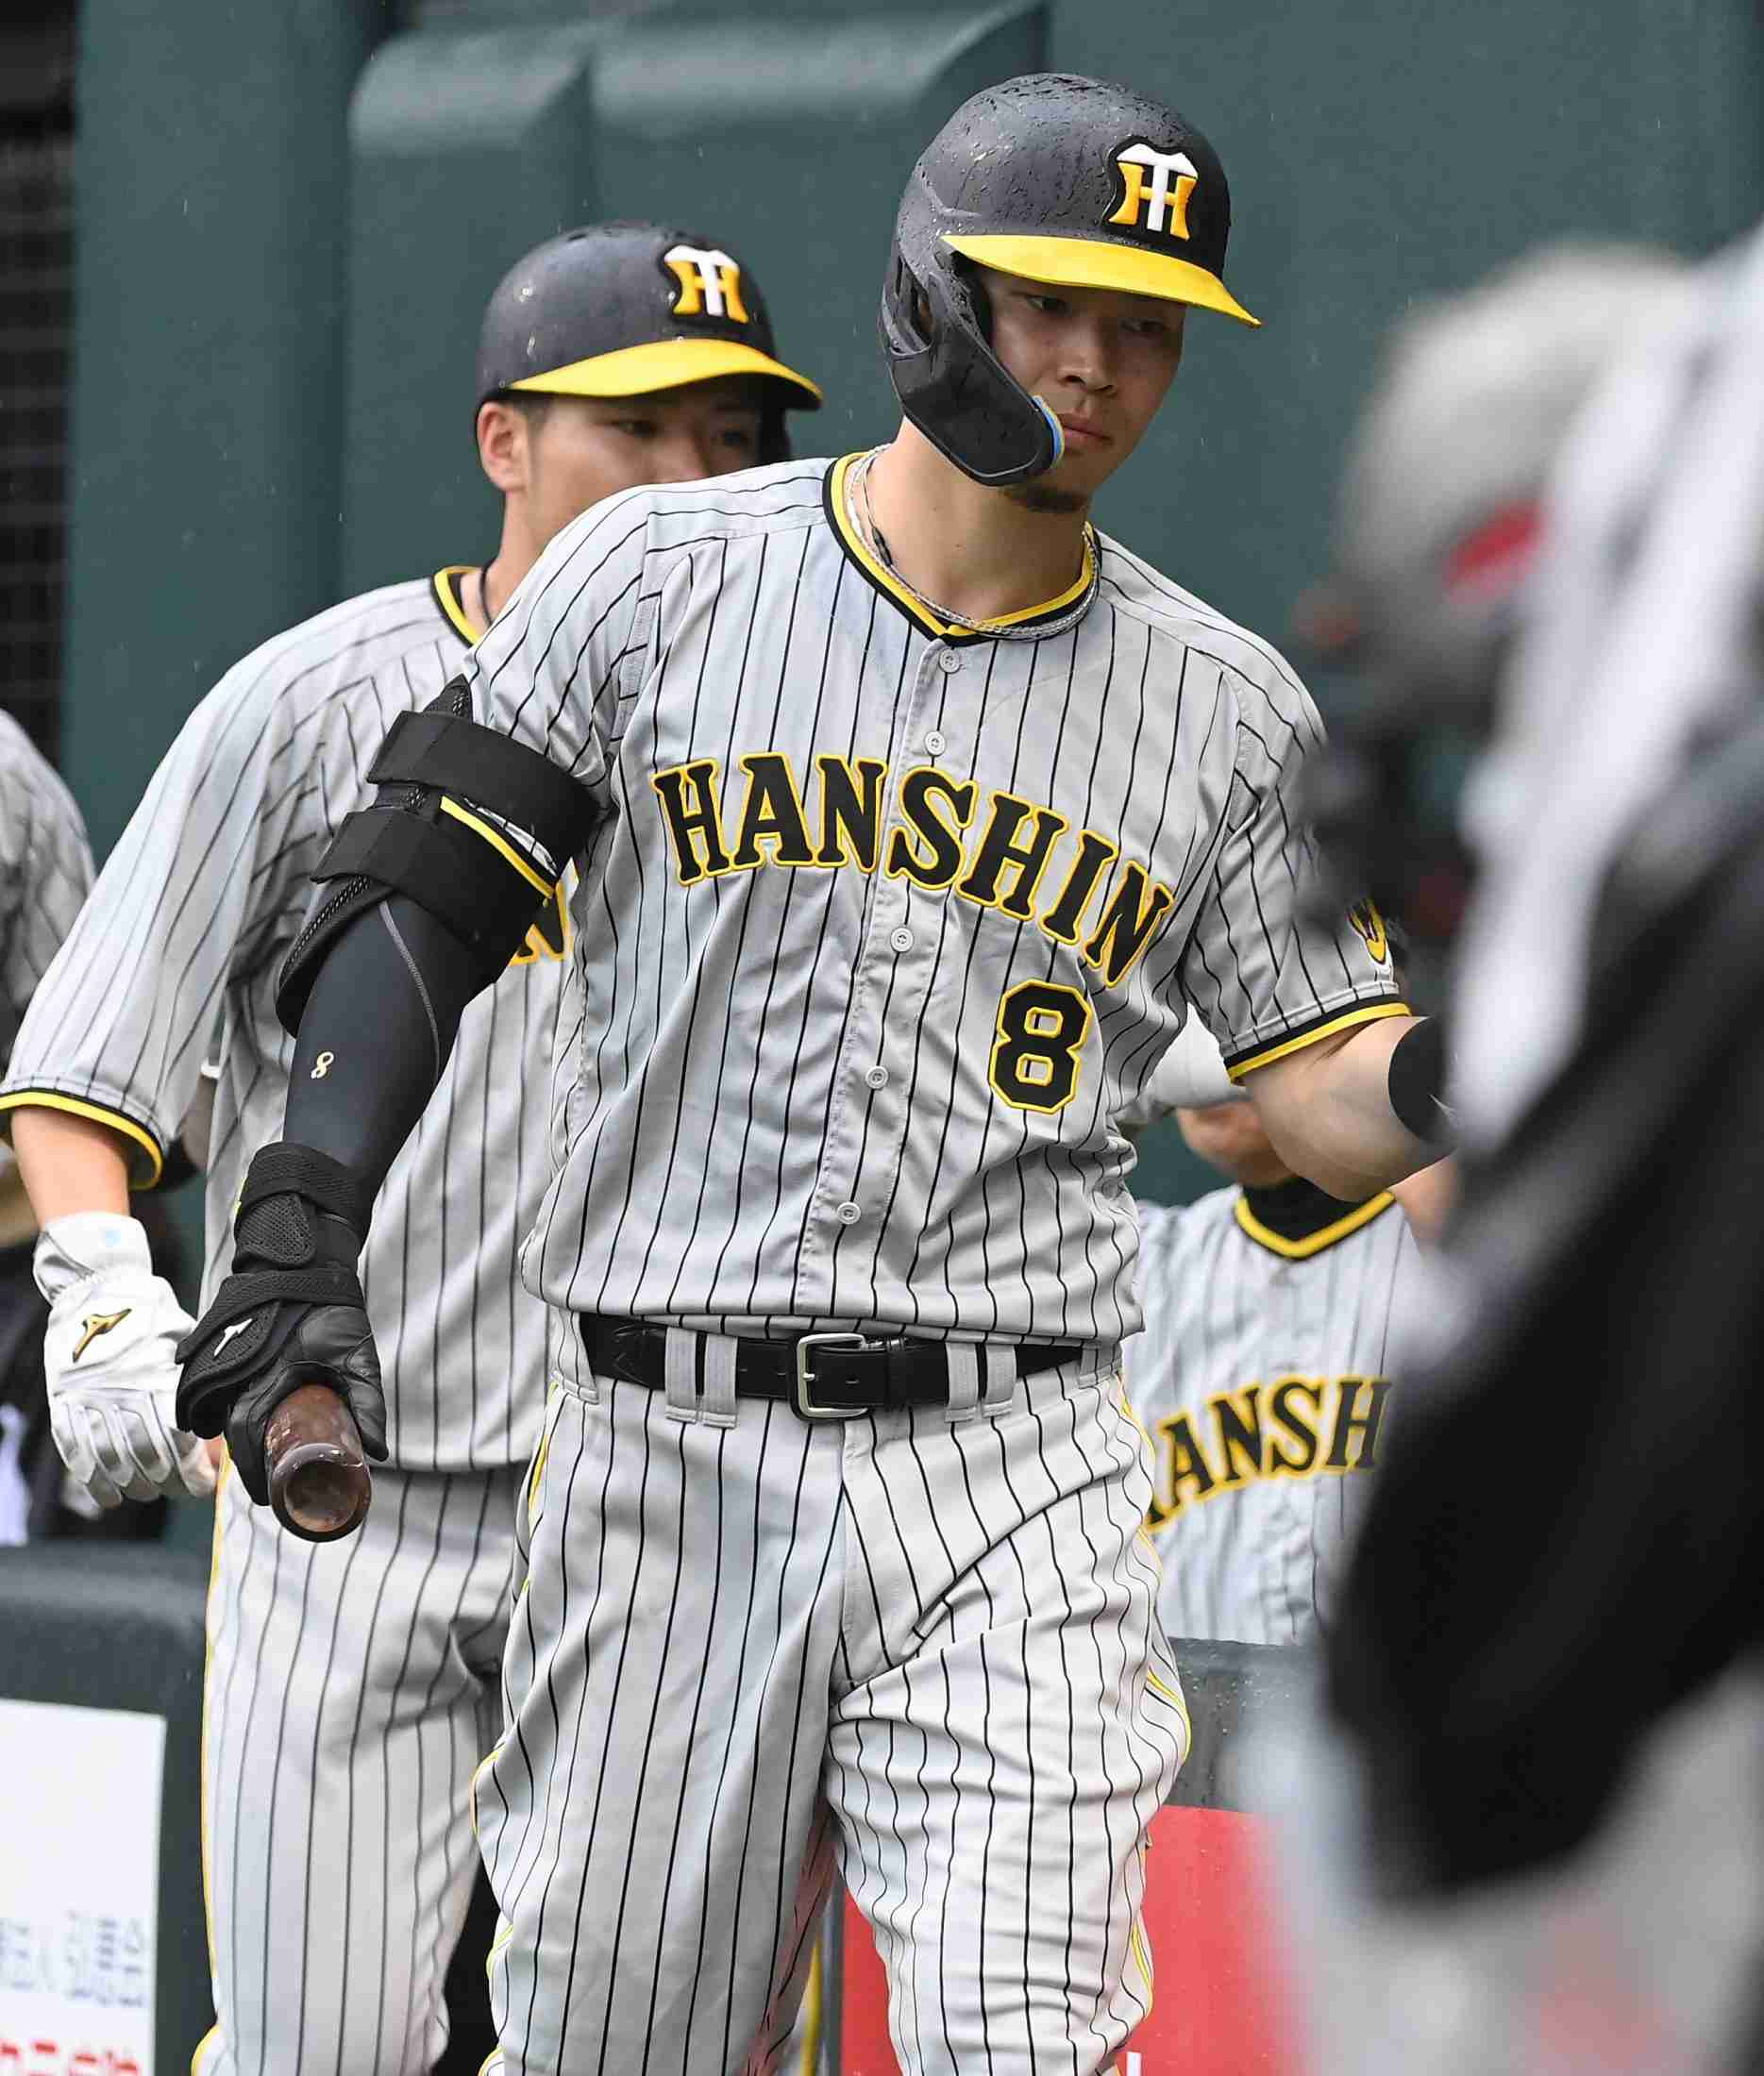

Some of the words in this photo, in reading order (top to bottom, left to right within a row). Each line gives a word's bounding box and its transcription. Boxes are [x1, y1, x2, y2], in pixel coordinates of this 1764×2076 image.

[654, 752, 1174, 988] HANSHIN
[311, 1051, 334, 1080] 8
[988, 979, 1092, 1114] 8
[1146, 1375, 1391, 1532] ANSH
